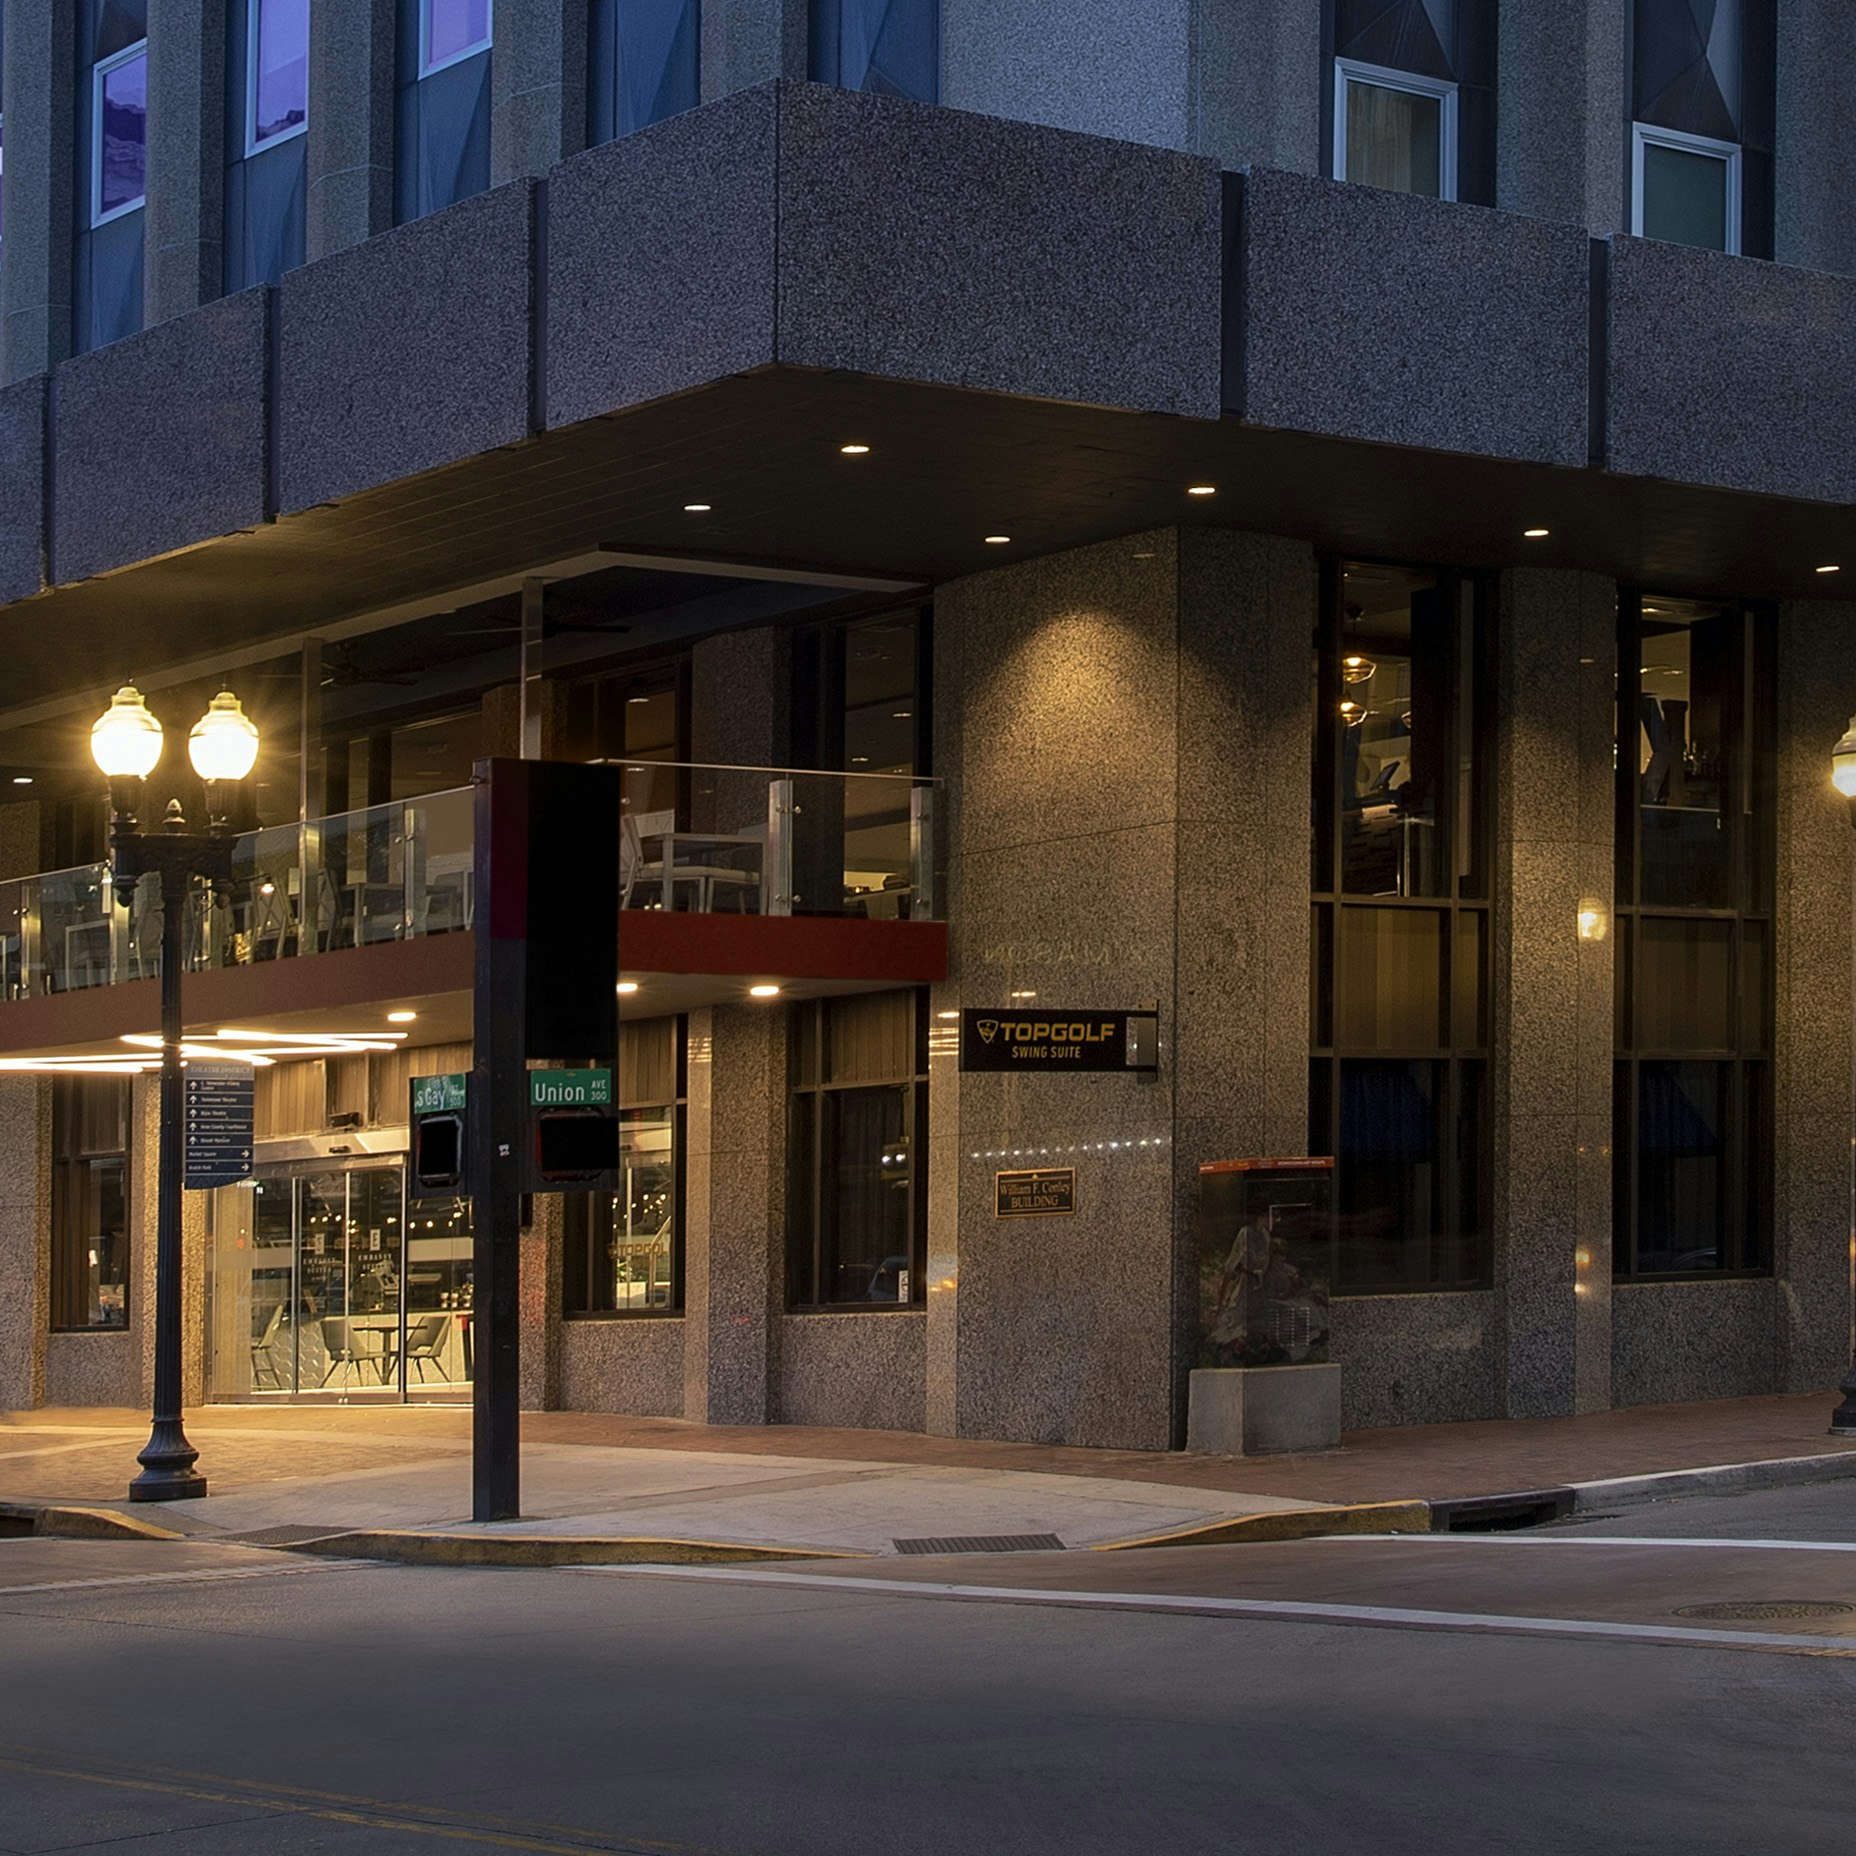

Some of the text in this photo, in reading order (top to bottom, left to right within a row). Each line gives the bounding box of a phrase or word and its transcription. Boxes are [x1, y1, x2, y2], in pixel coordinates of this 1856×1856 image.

[1000, 1022, 1116, 1042] TOPGOLF
[1011, 1045, 1082, 1059] SWING SUITE
[535, 1079, 606, 1102] Union AVE
[591, 1090, 607, 1101] 300
[1011, 1194, 1059, 1208] BUILDING
